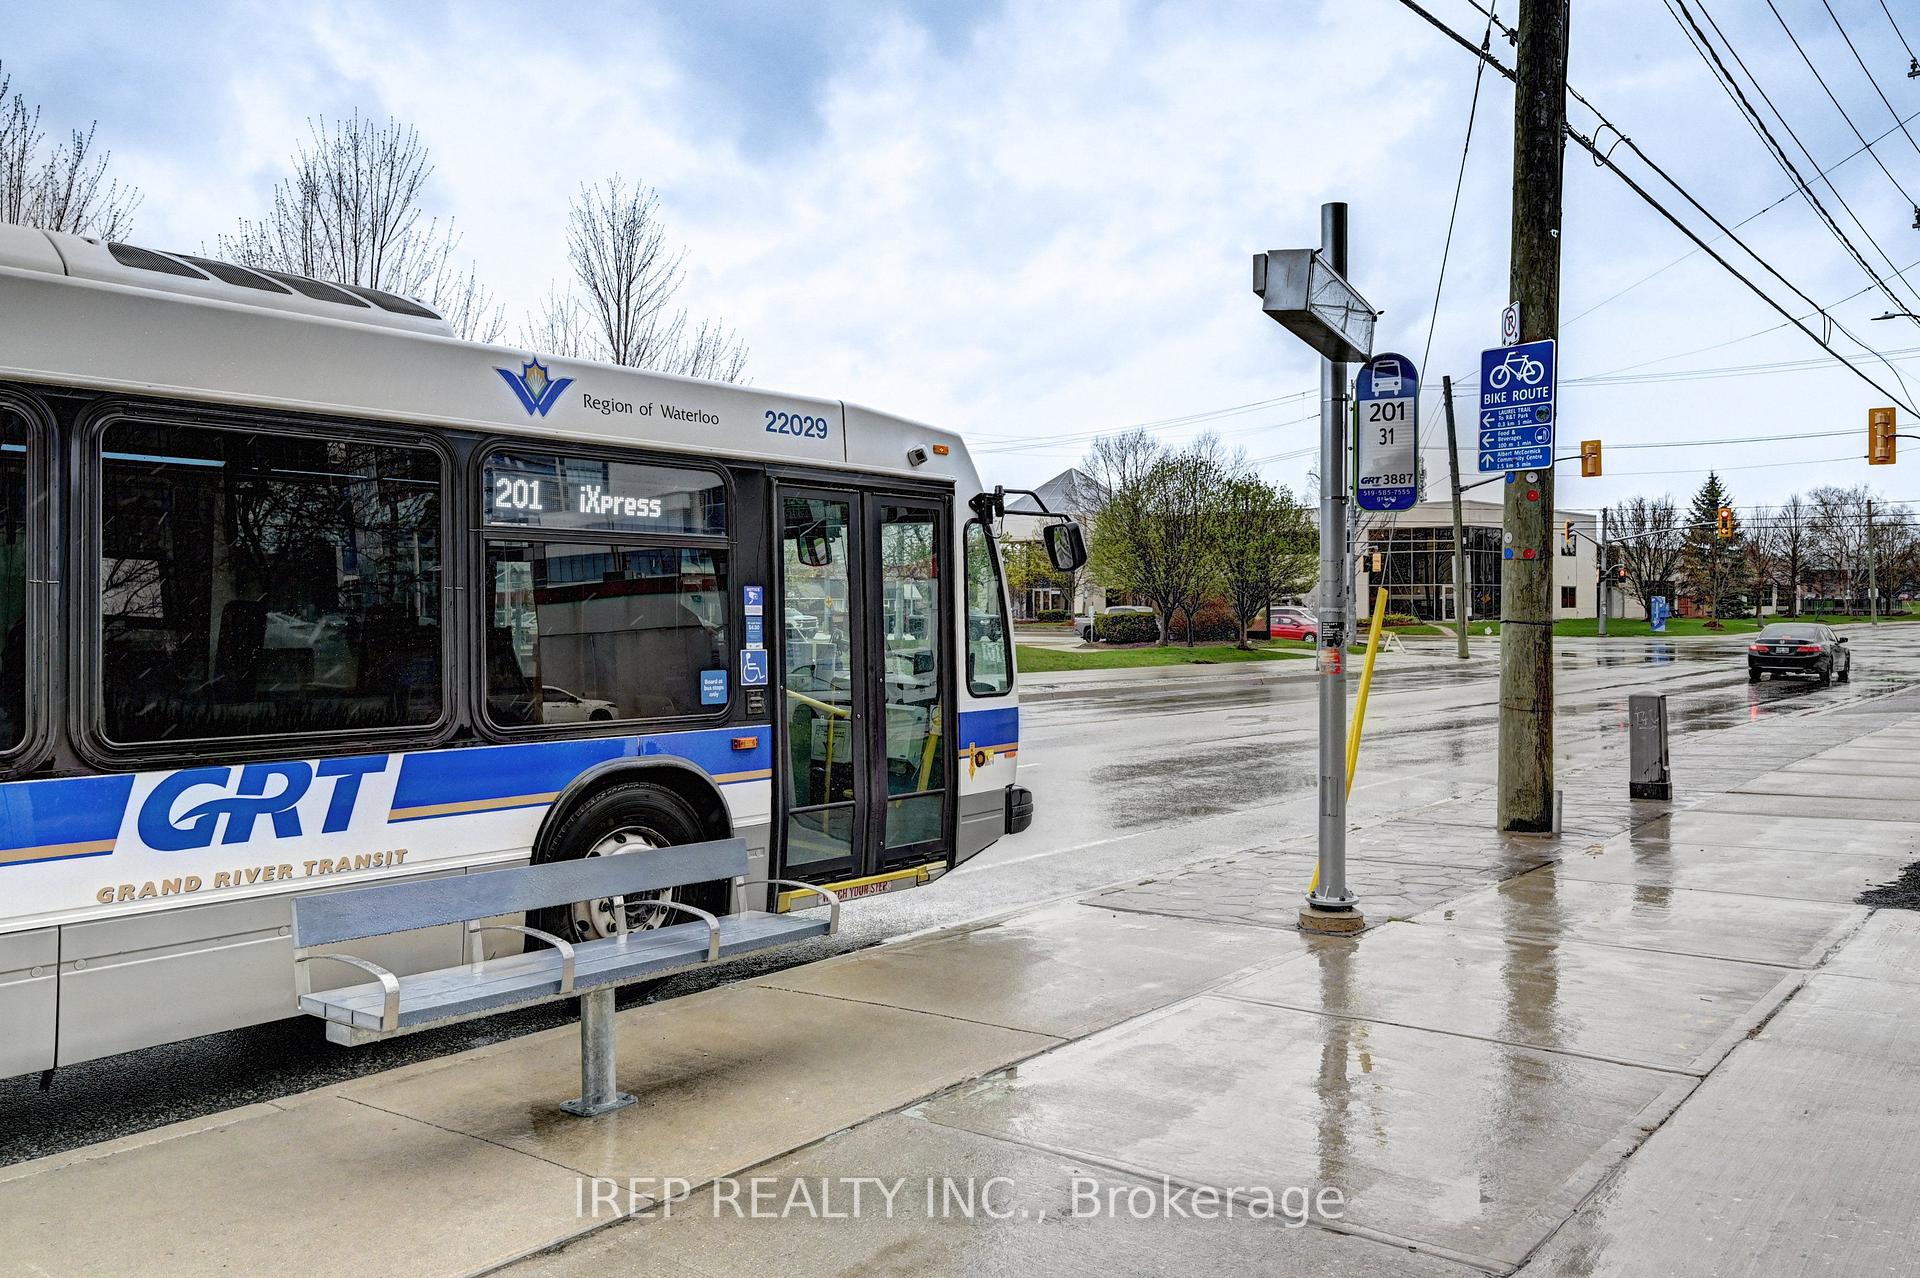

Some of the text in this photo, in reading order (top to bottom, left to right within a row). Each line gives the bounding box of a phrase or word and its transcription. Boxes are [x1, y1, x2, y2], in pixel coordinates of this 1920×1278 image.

[1484, 386, 1549, 405] BIKE ROUTE
[583, 393, 720, 425] Region of Waterloo
[1369, 401, 1405, 422] 201
[1498, 408, 1516, 416] LAUREL
[765, 410, 828, 439] 22029
[1497, 429, 1510, 437] Food
[1379, 427, 1394, 445] 31
[1513, 448, 1541, 456] McCormick
[1360, 473, 1414, 485] GRT 3887
[495, 478, 662, 518] 201 iXpress
[138, 754, 390, 851] GRT
[96, 848, 409, 904] GRAND RIVER TRANSIT
[822, 880, 888, 903] WTCH YOUR STEP
